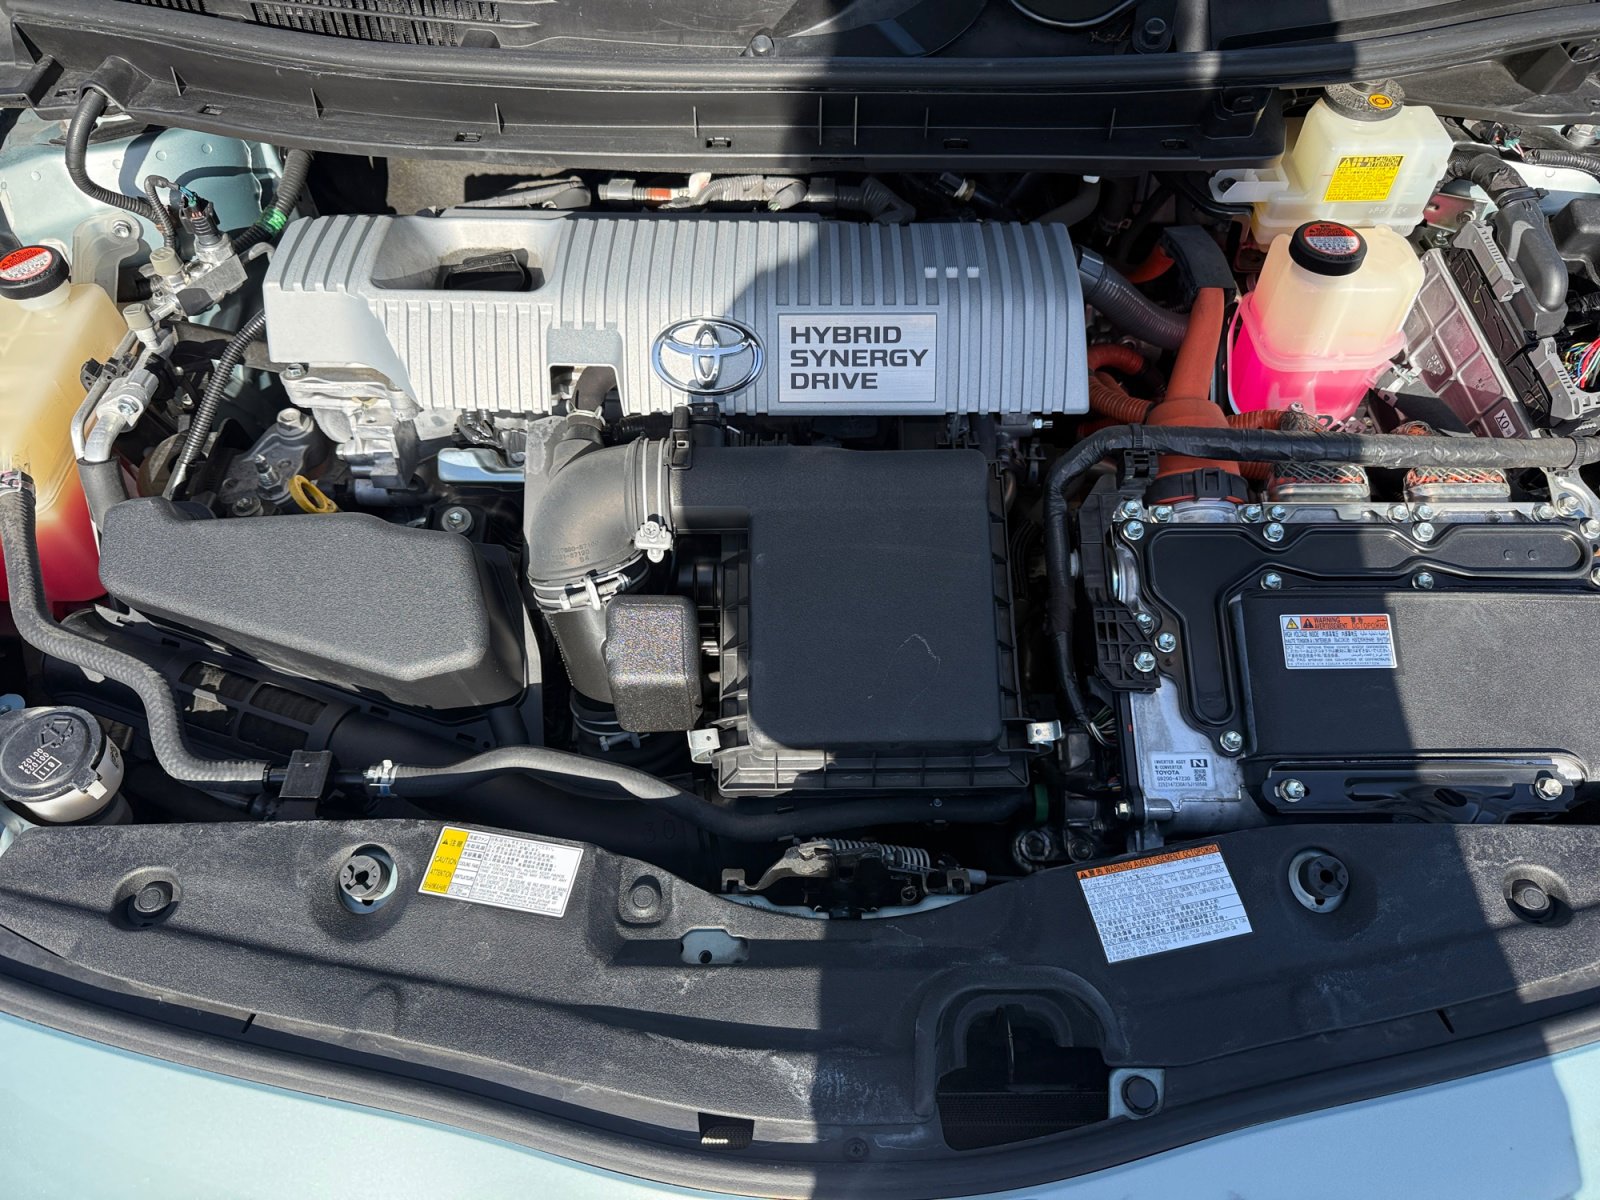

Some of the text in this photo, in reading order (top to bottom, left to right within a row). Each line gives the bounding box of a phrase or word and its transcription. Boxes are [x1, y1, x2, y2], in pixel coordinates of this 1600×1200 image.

[790, 326, 902, 344] HYBRID
[790, 349, 929, 367] SYNERGY
[790, 372, 878, 390] DRIVE
[18, 747, 44, 771] 001024
[435, 856, 457, 865] CAUTION
[1104, 862, 1133, 873] WARNING
[1134, 852, 1180, 867] AVERTISSEMENT
[430, 868, 452, 878] ATTENTION
